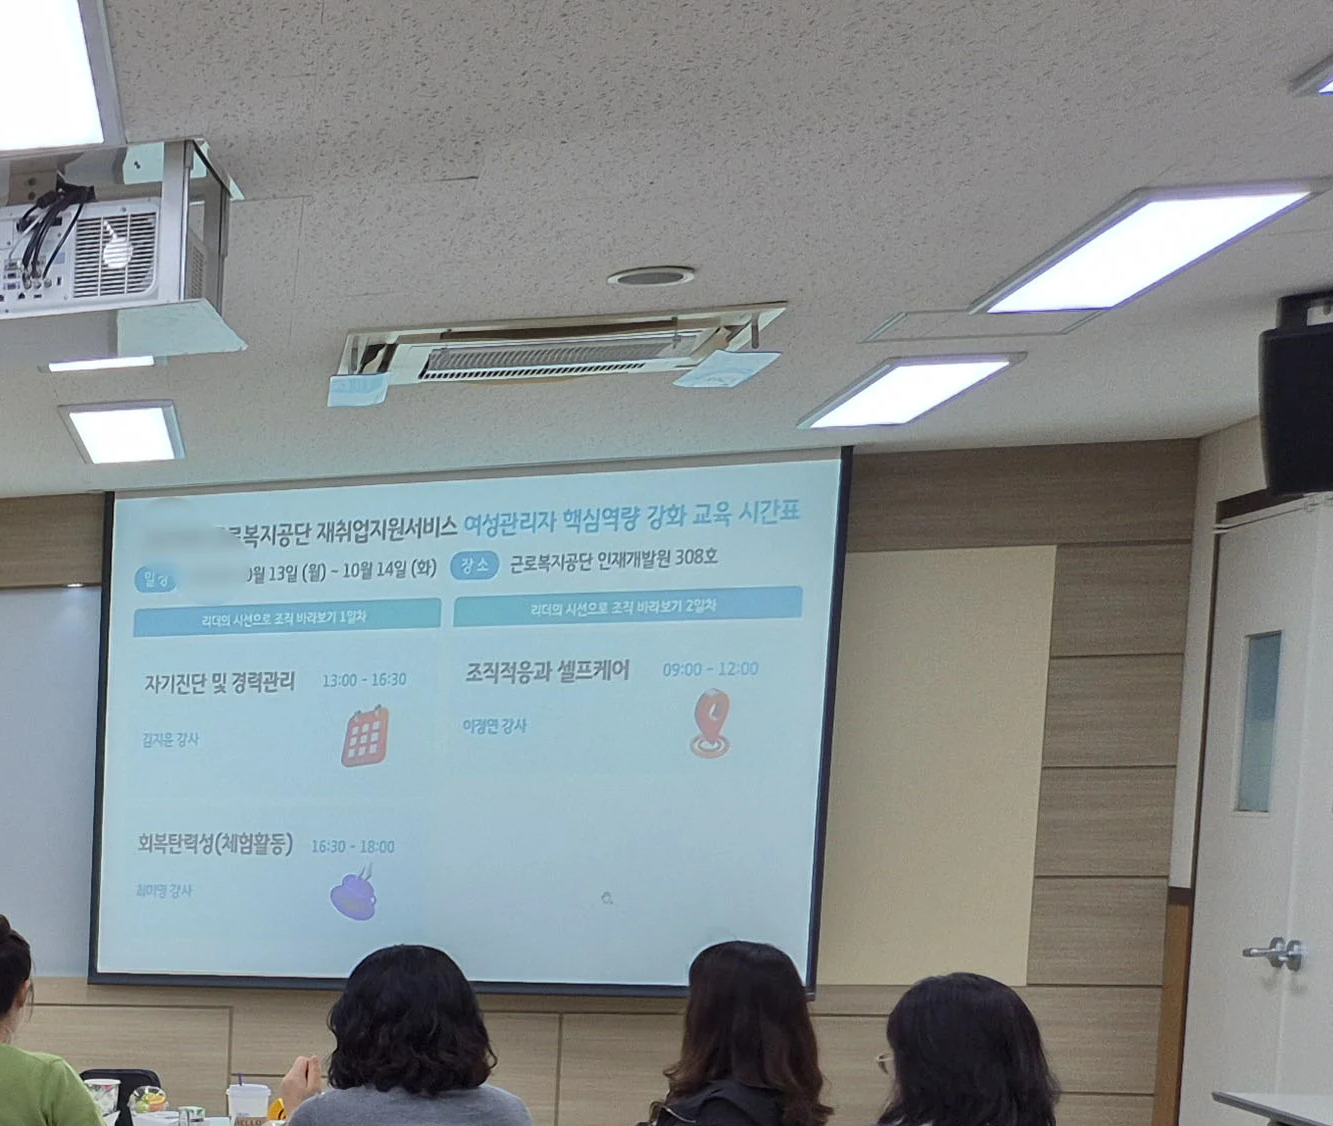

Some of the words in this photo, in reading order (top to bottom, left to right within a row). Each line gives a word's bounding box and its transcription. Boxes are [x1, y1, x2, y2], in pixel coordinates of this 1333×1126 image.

[223, 523, 312, 549] 복지공단
[317, 515, 458, 544] 재취업지원서비스
[463, 510, 556, 538] 여성관리자
[563, 504, 641, 534] 핵심역량
[647, 504, 685, 530] 강화
[692, 501, 733, 527] 교육
[738, 499, 802, 526] 시간표
[268, 564, 298, 584] 13일
[301, 562, 327, 583] (월)
[343, 561, 373, 580] 10월
[376, 559, 407, 578] 14일
[410, 557, 438, 579] (화)
[510, 552, 594, 574] 근로복지공단
[597, 549, 672, 571] 인재개발원
[675, 546, 719, 566] 308호
[530, 602, 563, 617] 리더의
[565, 601, 608, 618] 시선으로
[611, 600, 633, 616] 조직
[636, 598, 683, 616] 바라보기
[684, 597, 717, 614] 2일차
[201, 614, 232, 628] 리더의
[233, 612, 272, 627] 시선으로
[273, 611, 294, 626] 조직
[296, 610, 337, 625] 바라보기
[339, 609, 368, 624] 1일차
[465, 660, 553, 685] 조직적응과
[557, 658, 630, 683] 셀프케어
[662, 661, 703, 677] 09:00
[718, 660, 759, 676] 12:00
[144, 673, 207, 695] 자기진단
[211, 672, 227, 694] 및
[232, 670, 296, 694] 경력관리
[322, 673, 358, 688] 13:00
[371, 671, 407, 687] 16:30
[501, 717, 528, 734] 강사
[176, 732, 200, 748] 강사
[137, 831, 294, 857] 회복탄력성(체험활동)
[311, 839, 346, 854] 16:30
[360, 839, 395, 854] 18:00
